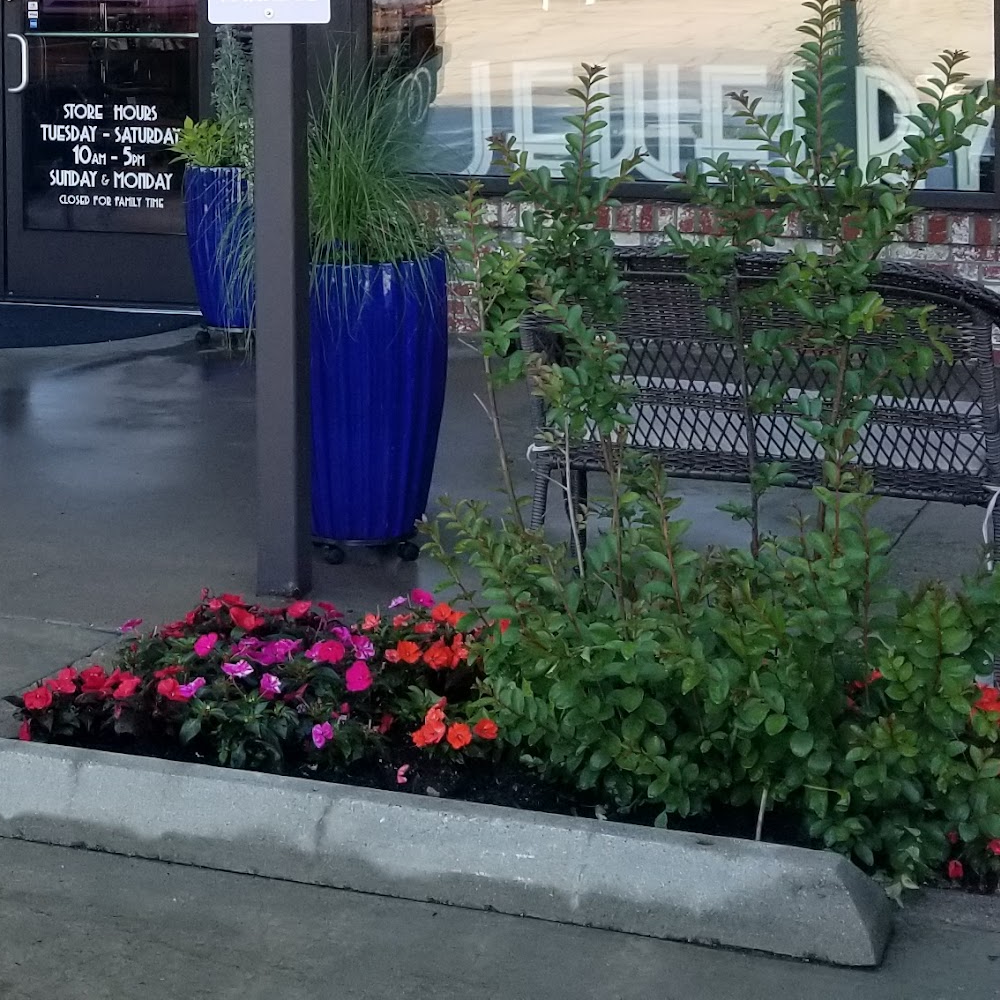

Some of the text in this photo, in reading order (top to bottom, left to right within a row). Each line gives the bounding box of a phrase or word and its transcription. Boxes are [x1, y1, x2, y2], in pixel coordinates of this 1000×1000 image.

[63, 104, 157, 121] STORE HOURS
[40, 124, 97, 142] TUESDAY
[114, 127, 180, 144] SATURDAY
[72, 144, 106, 165] 10AM
[123, 146, 145, 166] 5PM
[49, 169, 173, 190] SUNDAY & MONDAY
[59, 195, 164, 208] CLOSED FOR FAMILY TIME
